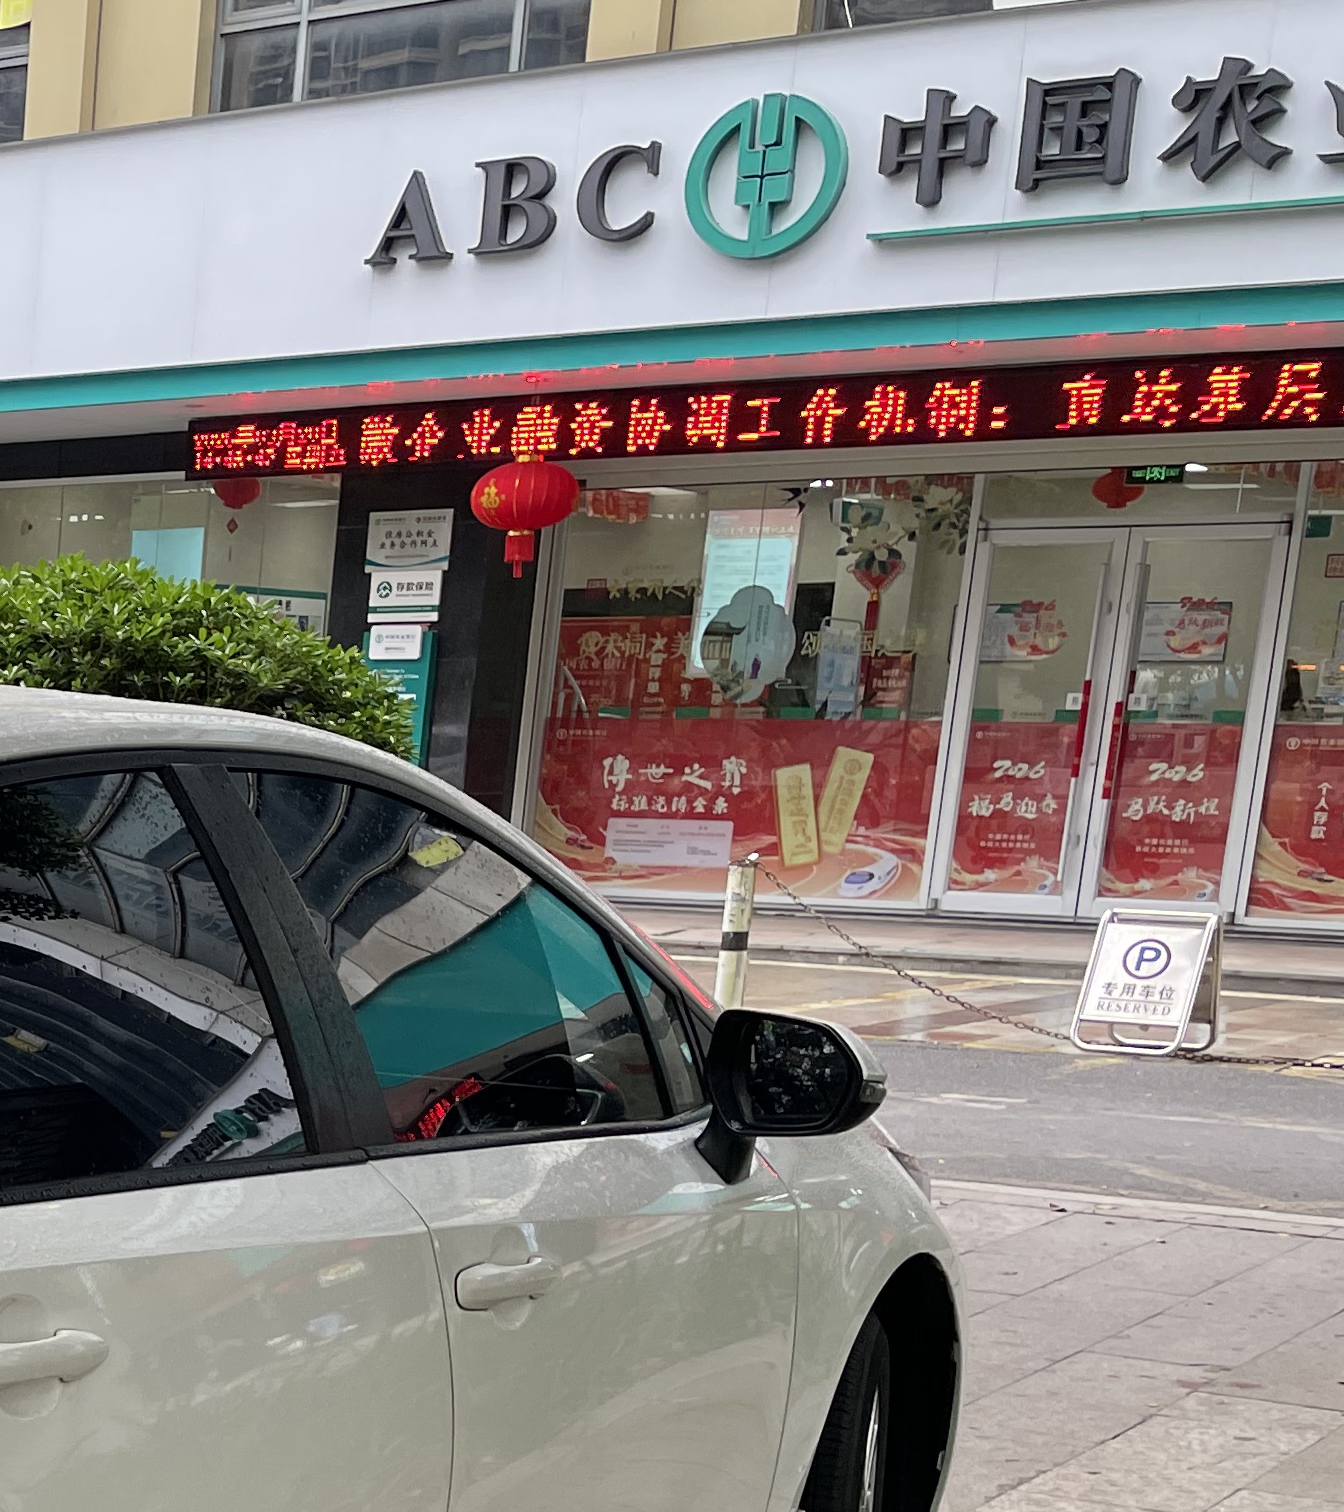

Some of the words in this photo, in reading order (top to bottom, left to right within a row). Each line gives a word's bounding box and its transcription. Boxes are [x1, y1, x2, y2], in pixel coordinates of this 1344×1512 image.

[877, 57, 1344, 207] 中国农
[363, 140, 662, 267] ABC
[1134, 946, 1162, 971] P
[1101, 981, 1176, 1001] 专用车位
[1096, 1000, 1172, 1016] RESERVED
